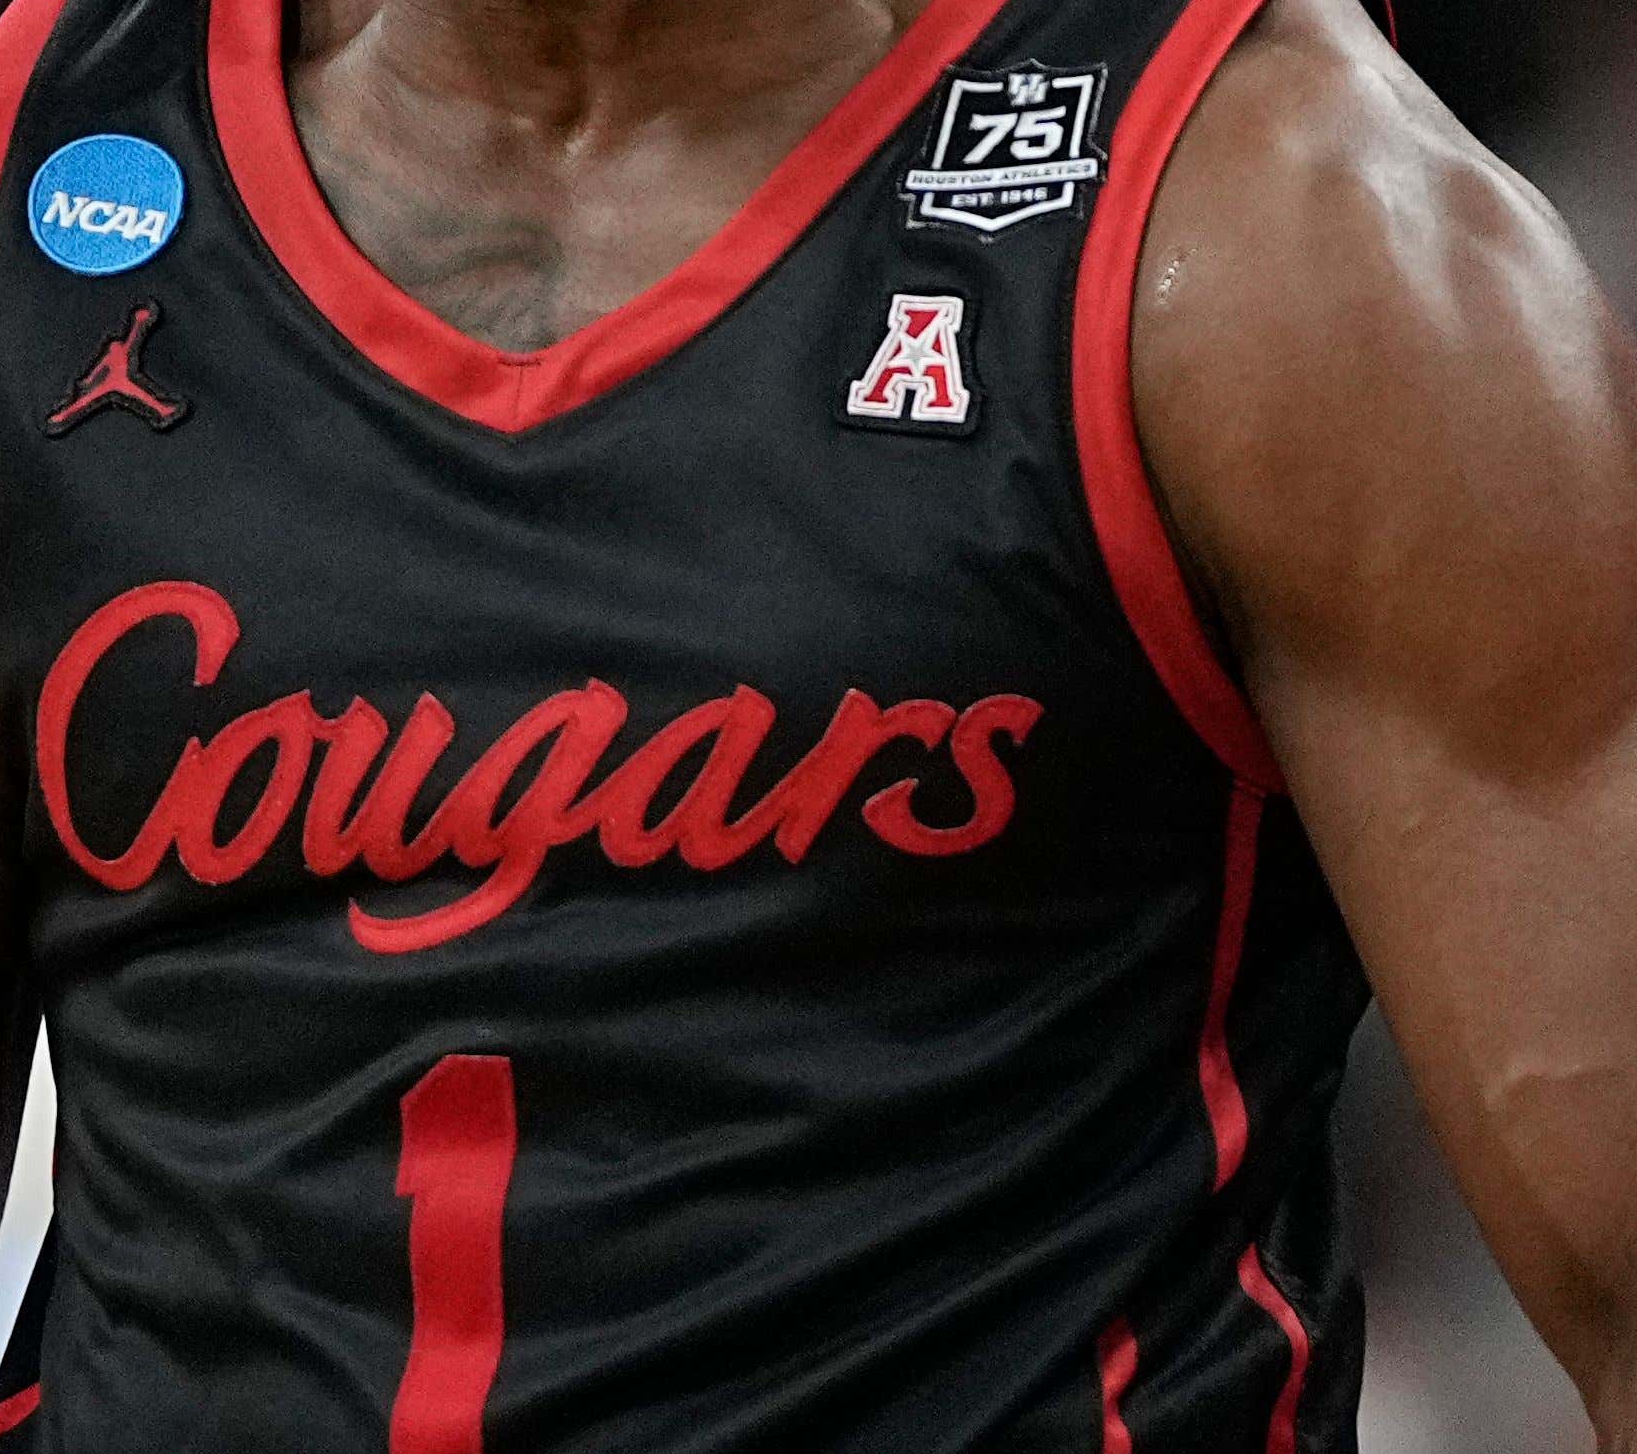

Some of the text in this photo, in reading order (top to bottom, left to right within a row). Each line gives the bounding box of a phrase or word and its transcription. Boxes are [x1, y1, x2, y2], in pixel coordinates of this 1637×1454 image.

[963, 105, 1066, 164] 75
[913, 172, 993, 186] HOUSTON
[42, 191, 168, 245] NCAA
[847, 294, 970, 423] A
[36, 580, 1043, 954] Cougars
